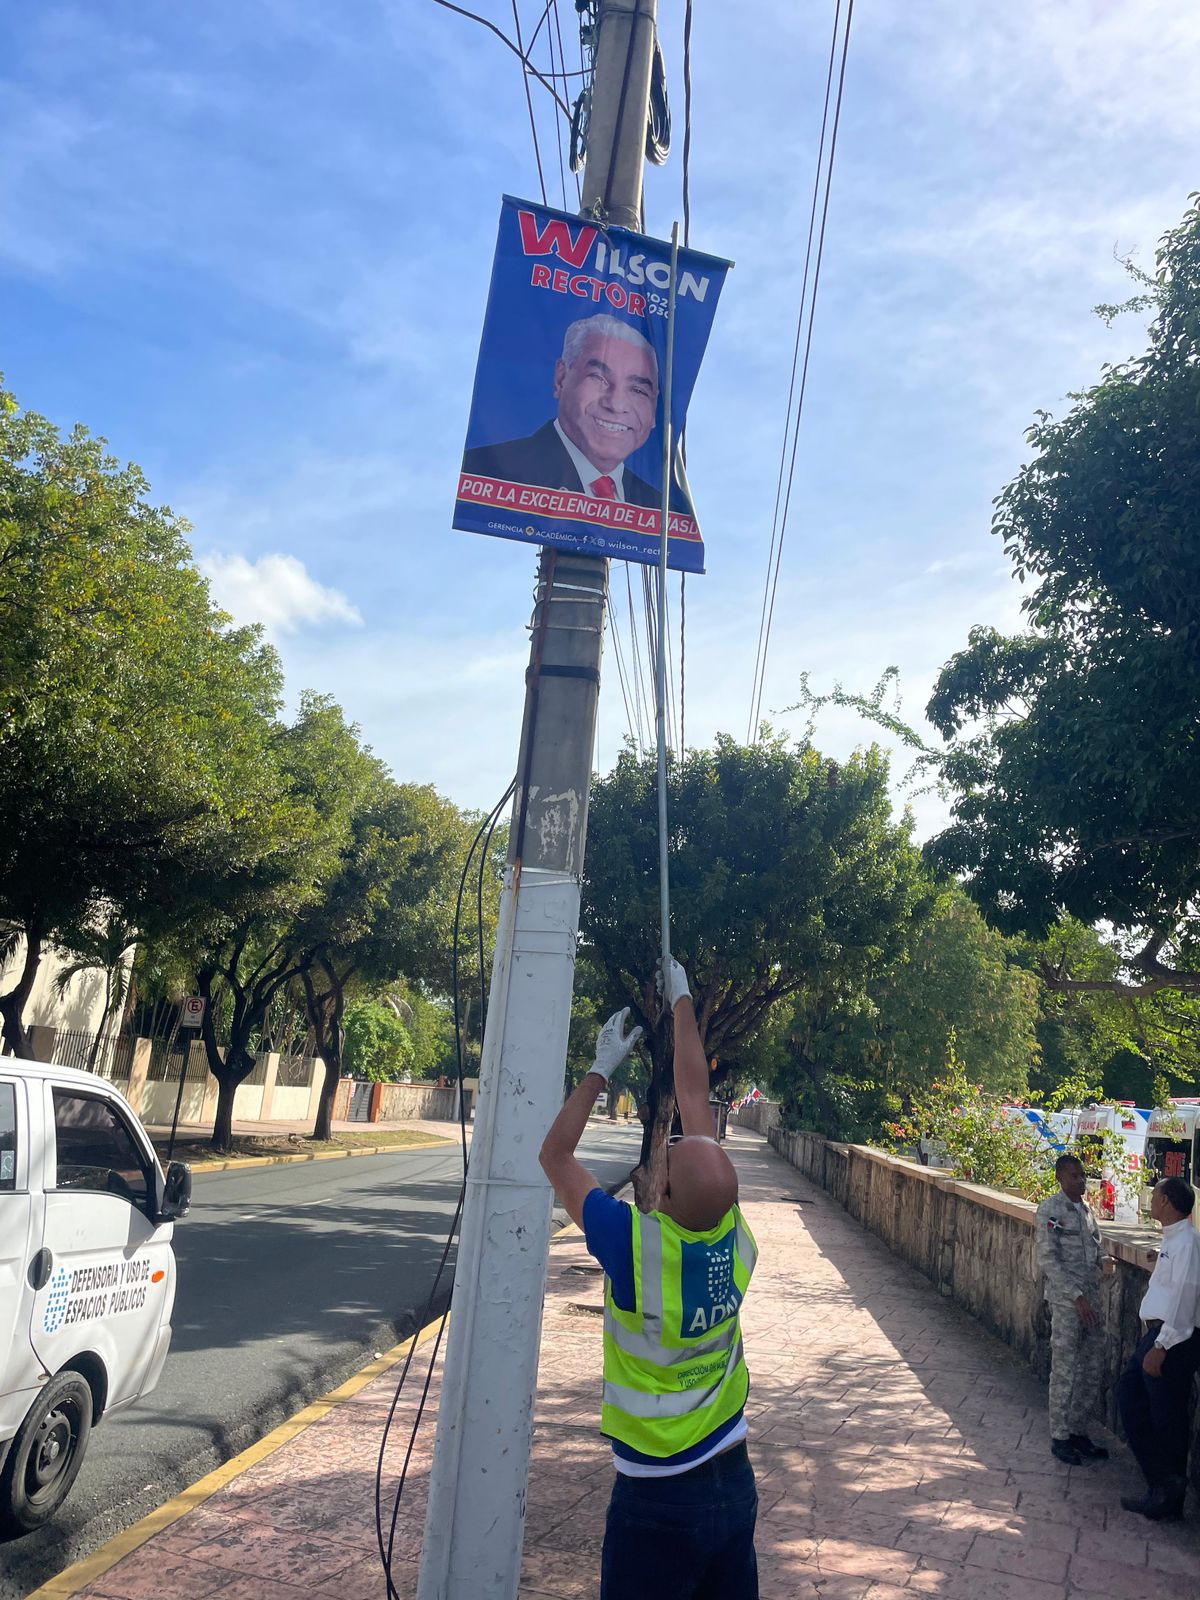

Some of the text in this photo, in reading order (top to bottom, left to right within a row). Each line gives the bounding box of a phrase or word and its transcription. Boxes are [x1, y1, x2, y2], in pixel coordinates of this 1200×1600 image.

[517, 209, 710, 303] WILSON
[531, 263, 647, 317] RECTOR
[461, 479, 699, 535] POR LA EXCELENCIA DE LA ASD
[487, 521, 524, 534] GERENCIA
[608, 541, 671, 557] wilson_rectr
[71, 1258, 150, 1294] DEFENSORIA Y USO DE
[65, 1286, 147, 1325] ESPACIOS PÚBLICOS
[689, 1294, 738, 1332] ADN
